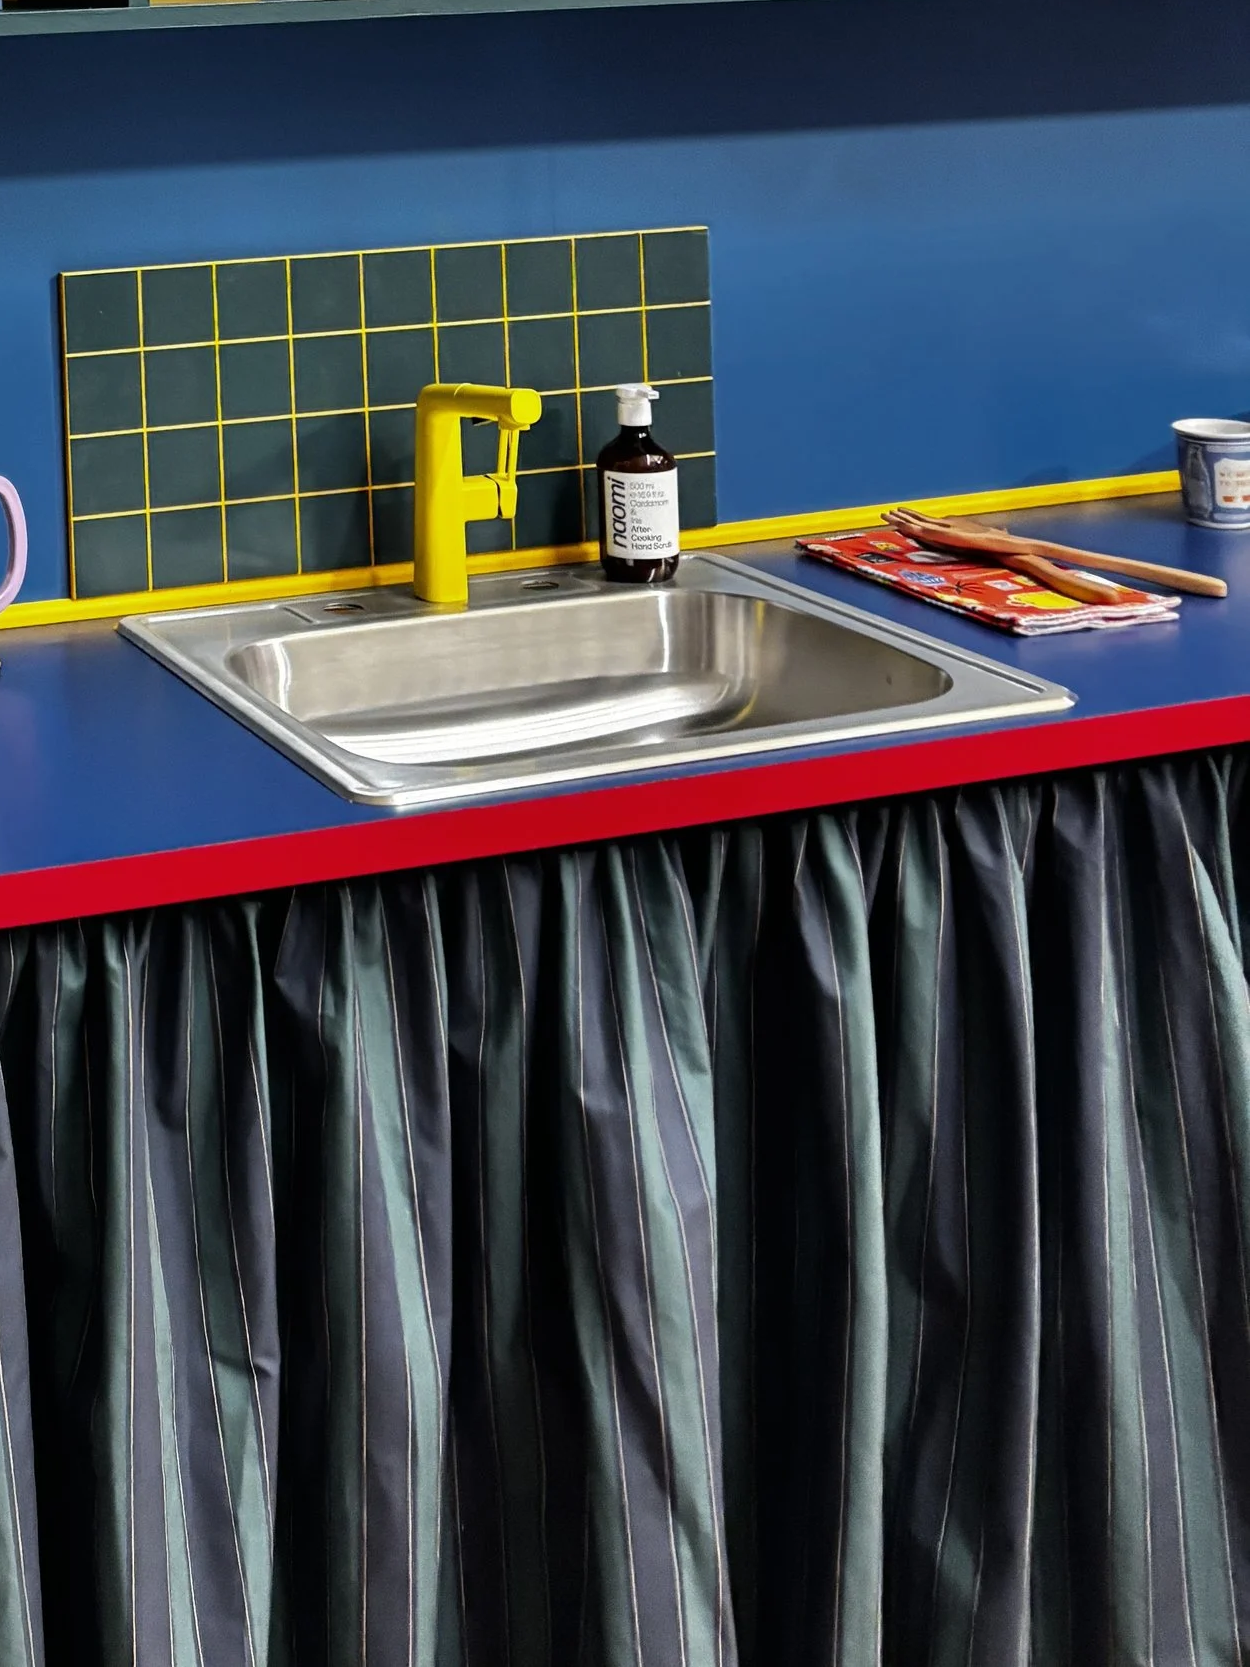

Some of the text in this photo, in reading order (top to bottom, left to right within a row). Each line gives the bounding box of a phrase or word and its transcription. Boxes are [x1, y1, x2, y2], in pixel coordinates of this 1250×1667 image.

[607, 476, 627, 549] naomi
[631, 534, 662, 542] Cooking
[631, 543, 652, 551] Hand
